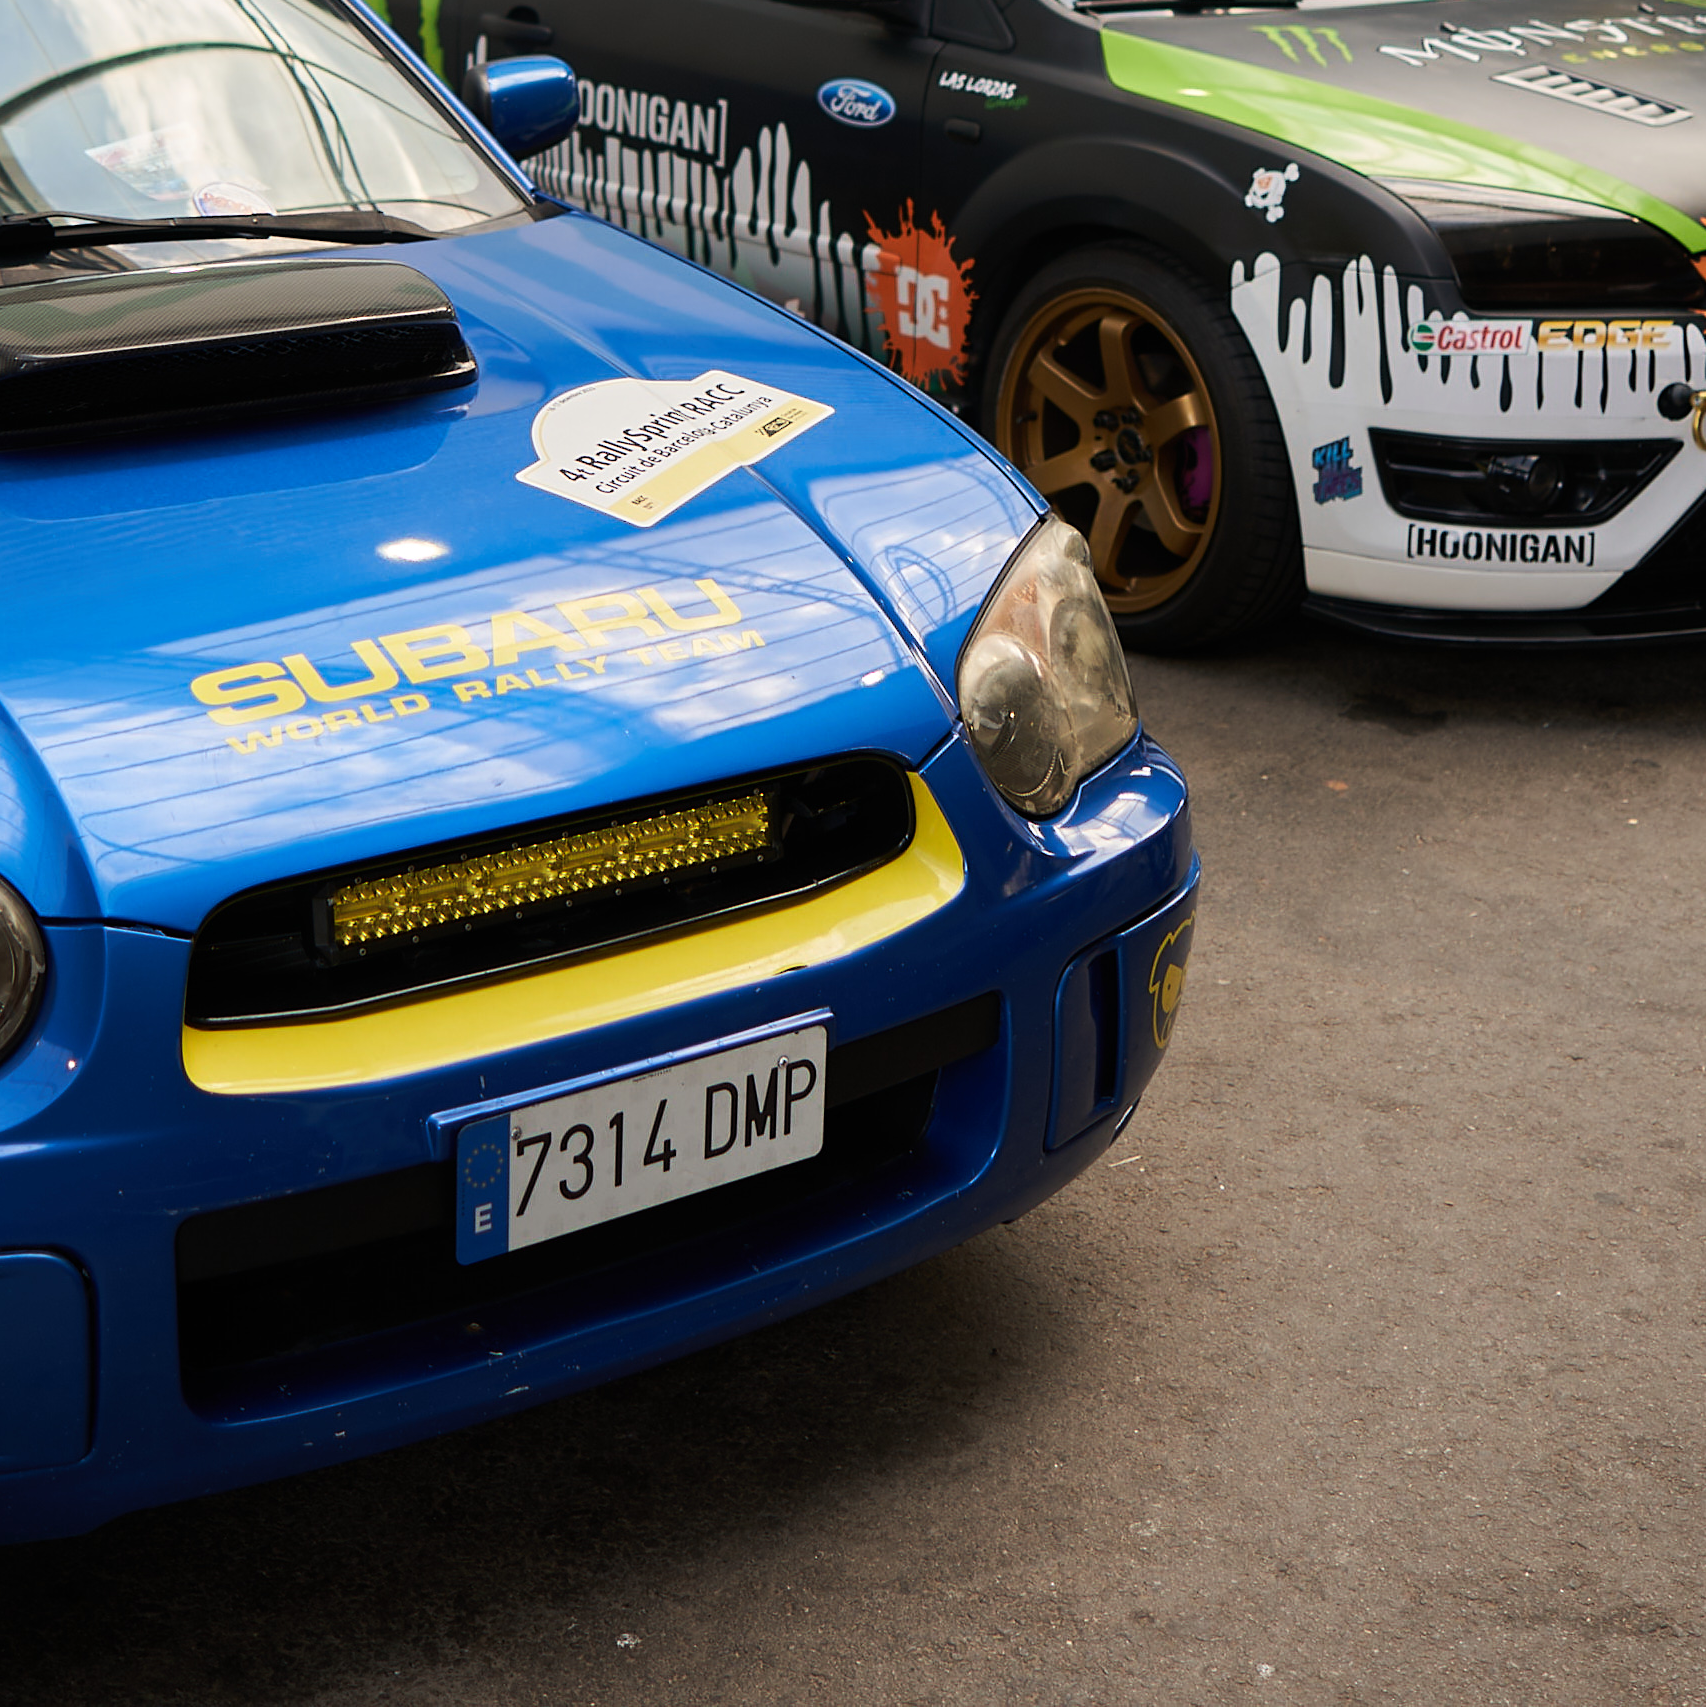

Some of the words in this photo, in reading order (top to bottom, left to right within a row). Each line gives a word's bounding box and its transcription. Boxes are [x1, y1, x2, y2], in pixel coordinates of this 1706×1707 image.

[829, 84, 882, 122] Ford
[939, 71, 967, 90] LAS
[578, 78, 730, 168] OONIGAN]
[1436, 323, 1524, 353] Castrol
[1537, 319, 1676, 352] EDGE
[576, 405, 694, 470] RallySprint
[681, 383, 745, 418] RACC
[595, 465, 645, 495] Circuit
[640, 449, 661, 468] de
[1314, 439, 1352, 467] KILL
[1407, 522, 1595, 567] [HOONIGAN]
[190, 578, 744, 727] SUBARU
[225, 691, 431, 756] WORLD
[452, 651, 609, 703] RALLY
[631, 628, 767, 668] TEAM
[516, 1099, 678, 1218] 7314
[704, 1058, 817, 1160] DMP
[474, 1202, 493, 1235] E
